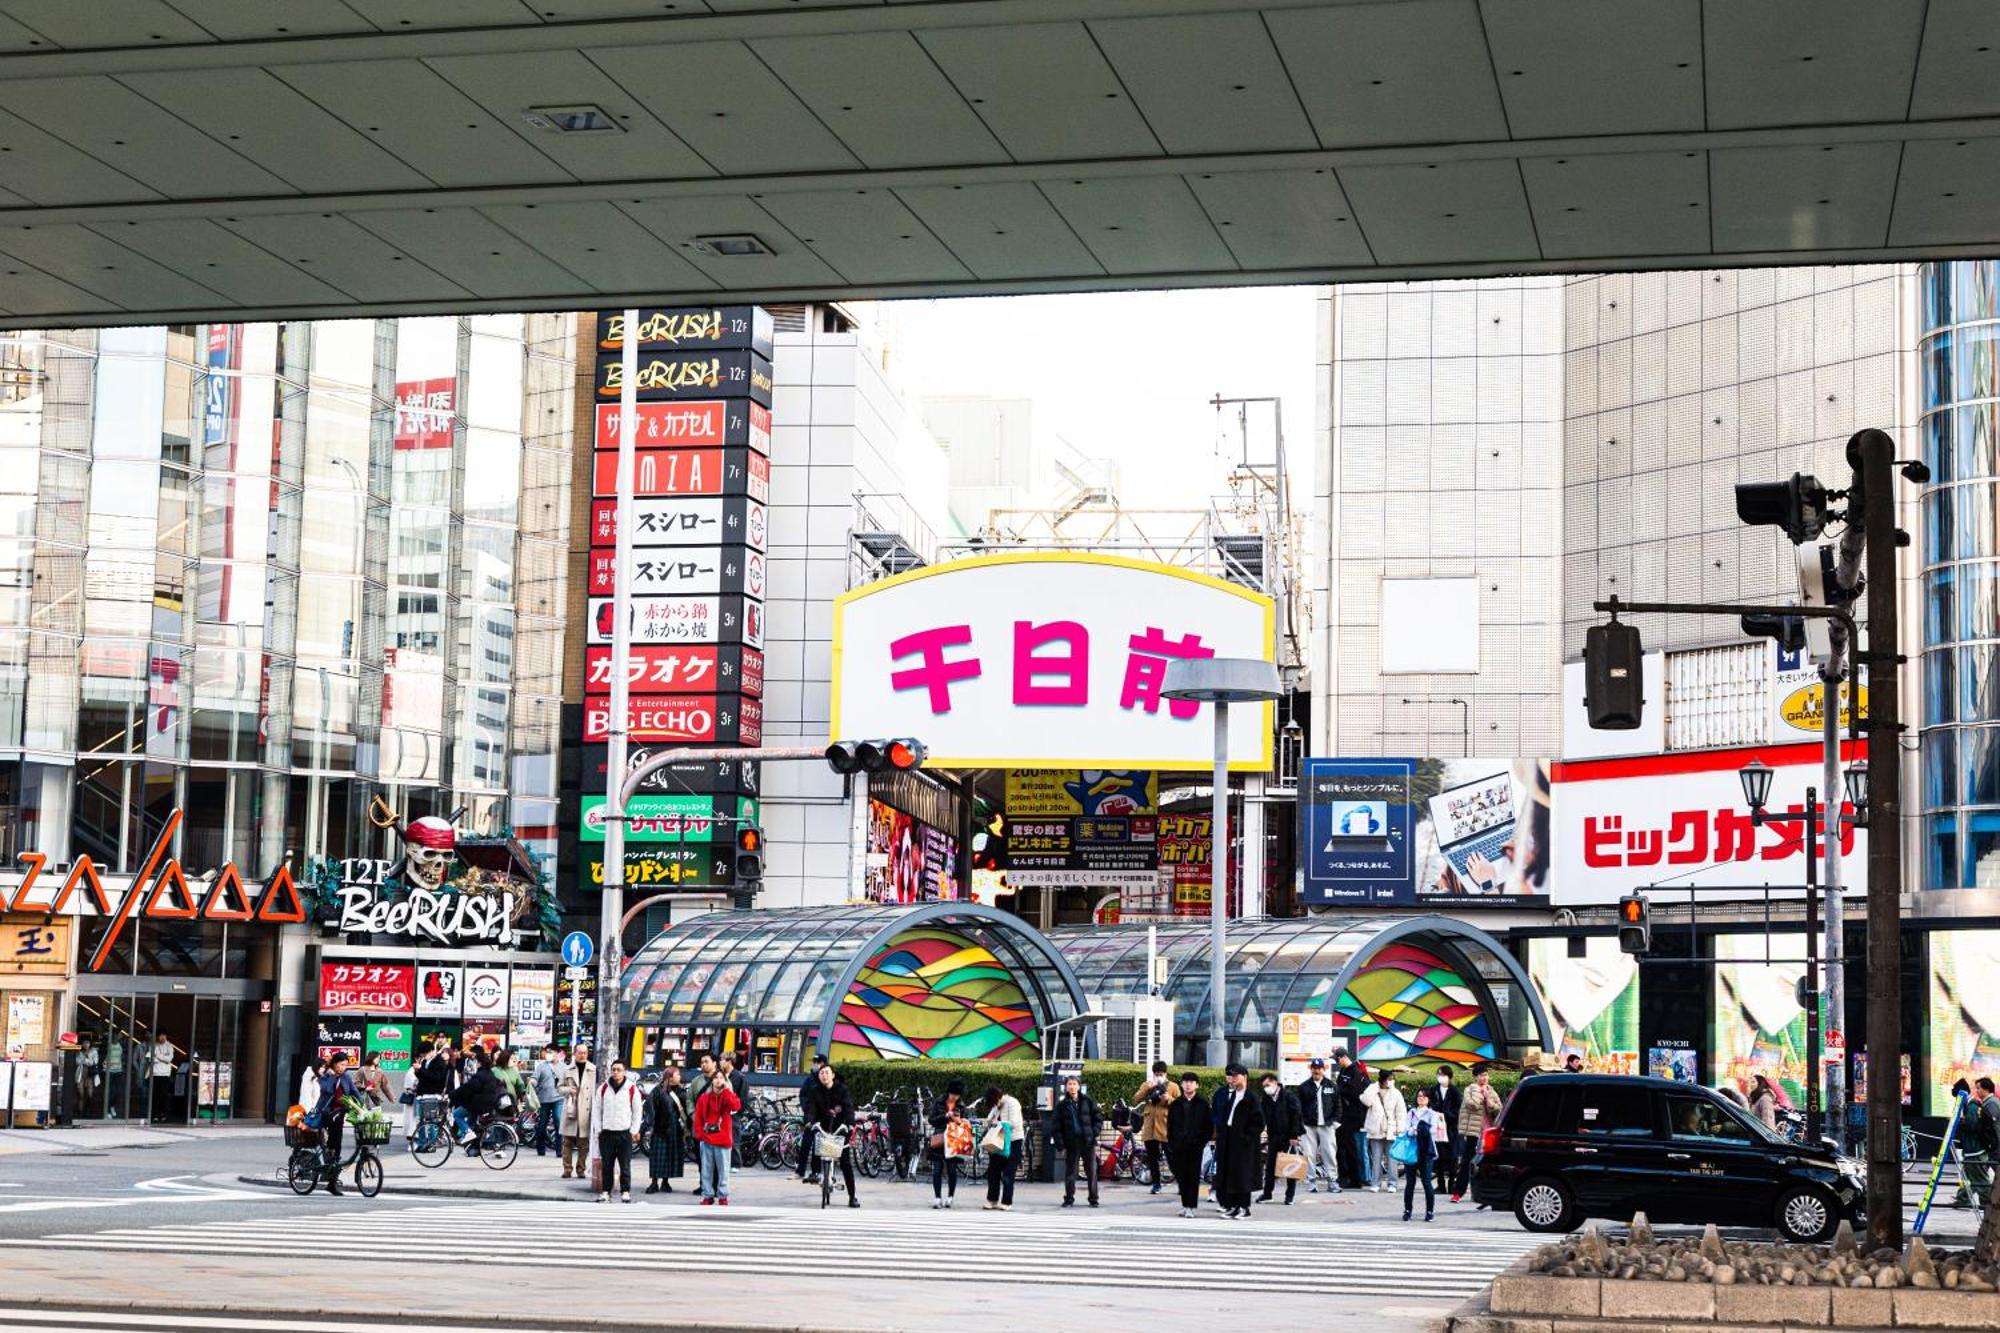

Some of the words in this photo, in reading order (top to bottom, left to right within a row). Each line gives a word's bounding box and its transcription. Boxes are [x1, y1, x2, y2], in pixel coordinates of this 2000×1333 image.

[606, 311, 722, 344] BeRUSH
[732, 319, 748, 333] 12F
[604, 357, 720, 391] BeRUSH
[730, 367, 746, 381] 12F
[606, 412, 645, 438] サナ
[664, 411, 715, 437] カプセル
[731, 416, 742, 429] 7F
[614, 453, 703, 493] MZA
[729, 464, 740, 478] 7F
[636, 511, 717, 533] スシロー
[728, 514, 738, 528] 4F
[634, 561, 714, 582] スシロー
[725, 562, 736, 576] 4F
[644, 602, 708, 619] 赤から鍋
[724, 613, 735, 627] 3F
[643, 622, 707, 639] 赤から焼
[722, 661, 733, 676] 3F
[889, 619, 1216, 720] 千日前
[1776, 671, 1821, 685] 大きいサイ
[637, 699, 699, 708] Entertainment
[588, 709, 636, 735] BG
[640, 709, 712, 735] ECHO
[720, 711, 732, 726] 3F
[1787, 709, 1825, 721] GRAN
[719, 762, 731, 776] 2F
[1583, 800, 1855, 868] ビックカメラ
[340, 858, 393, 885] 12F
[715, 860, 727, 875] 2F
[333, 965, 402, 983] カラオケ
[325, 989, 357, 1007] BIG
[360, 990, 407, 1009] ECHO
[470, 987, 502, 997] スシロー
